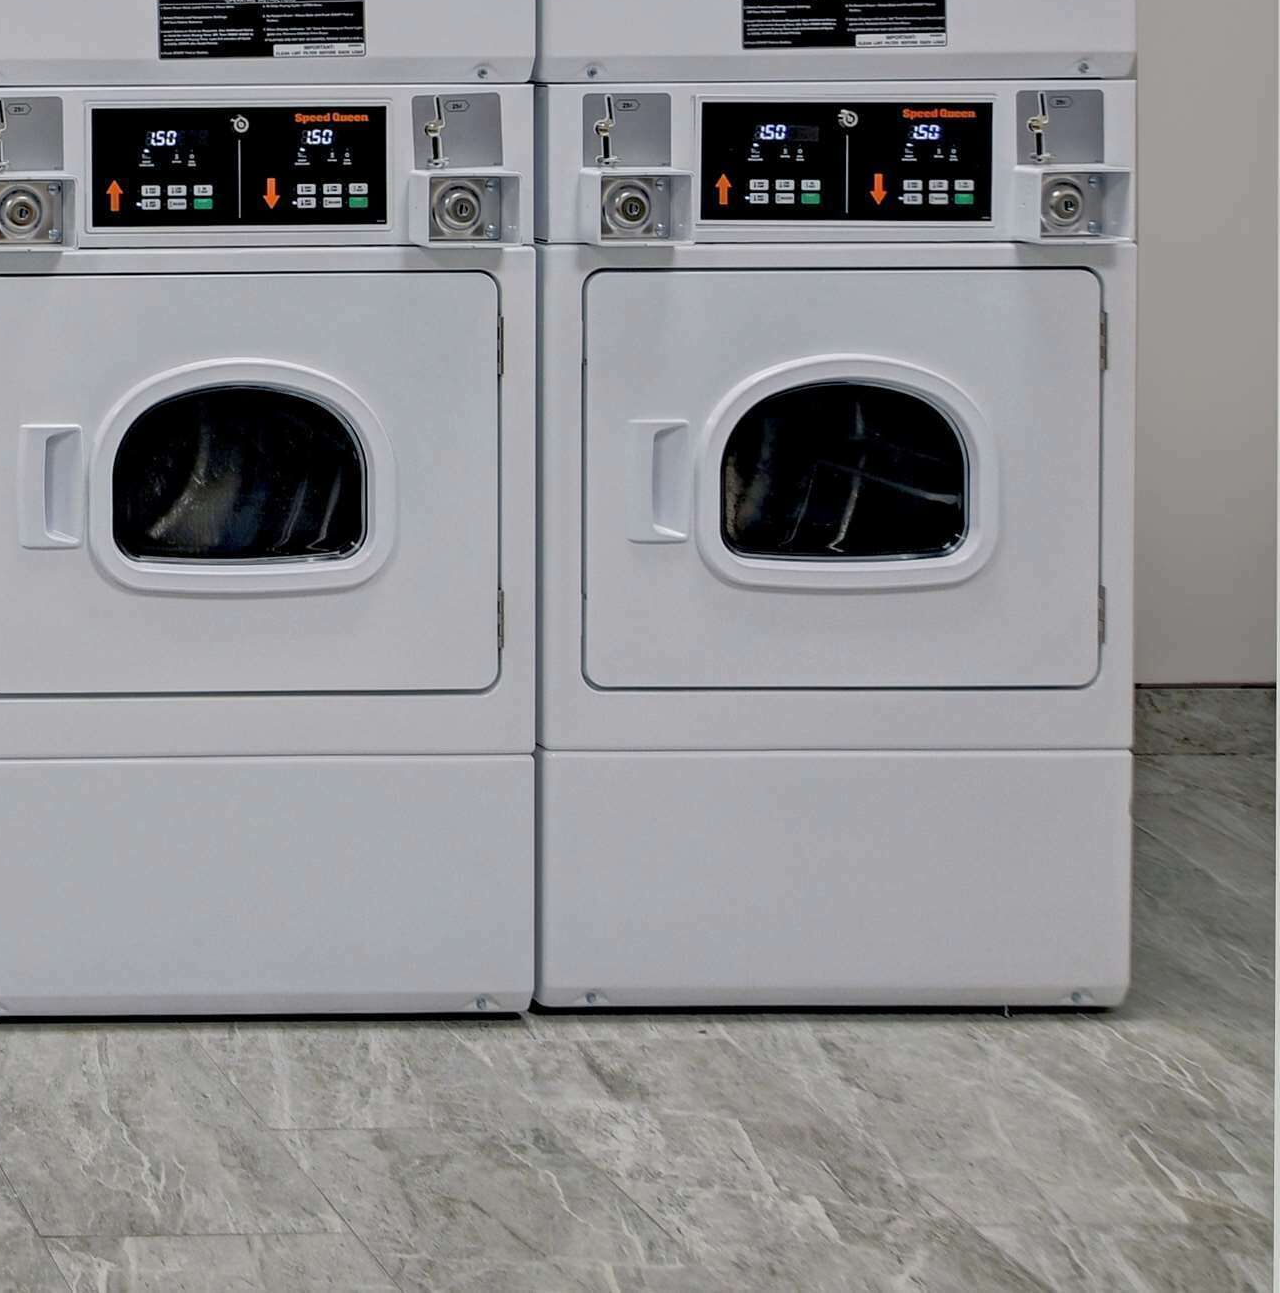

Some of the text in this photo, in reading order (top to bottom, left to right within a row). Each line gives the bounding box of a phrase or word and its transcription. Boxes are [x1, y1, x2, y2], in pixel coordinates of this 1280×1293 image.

[294, 112, 370, 124] Speed Queen
[902, 108, 976, 120] Speed Queen
